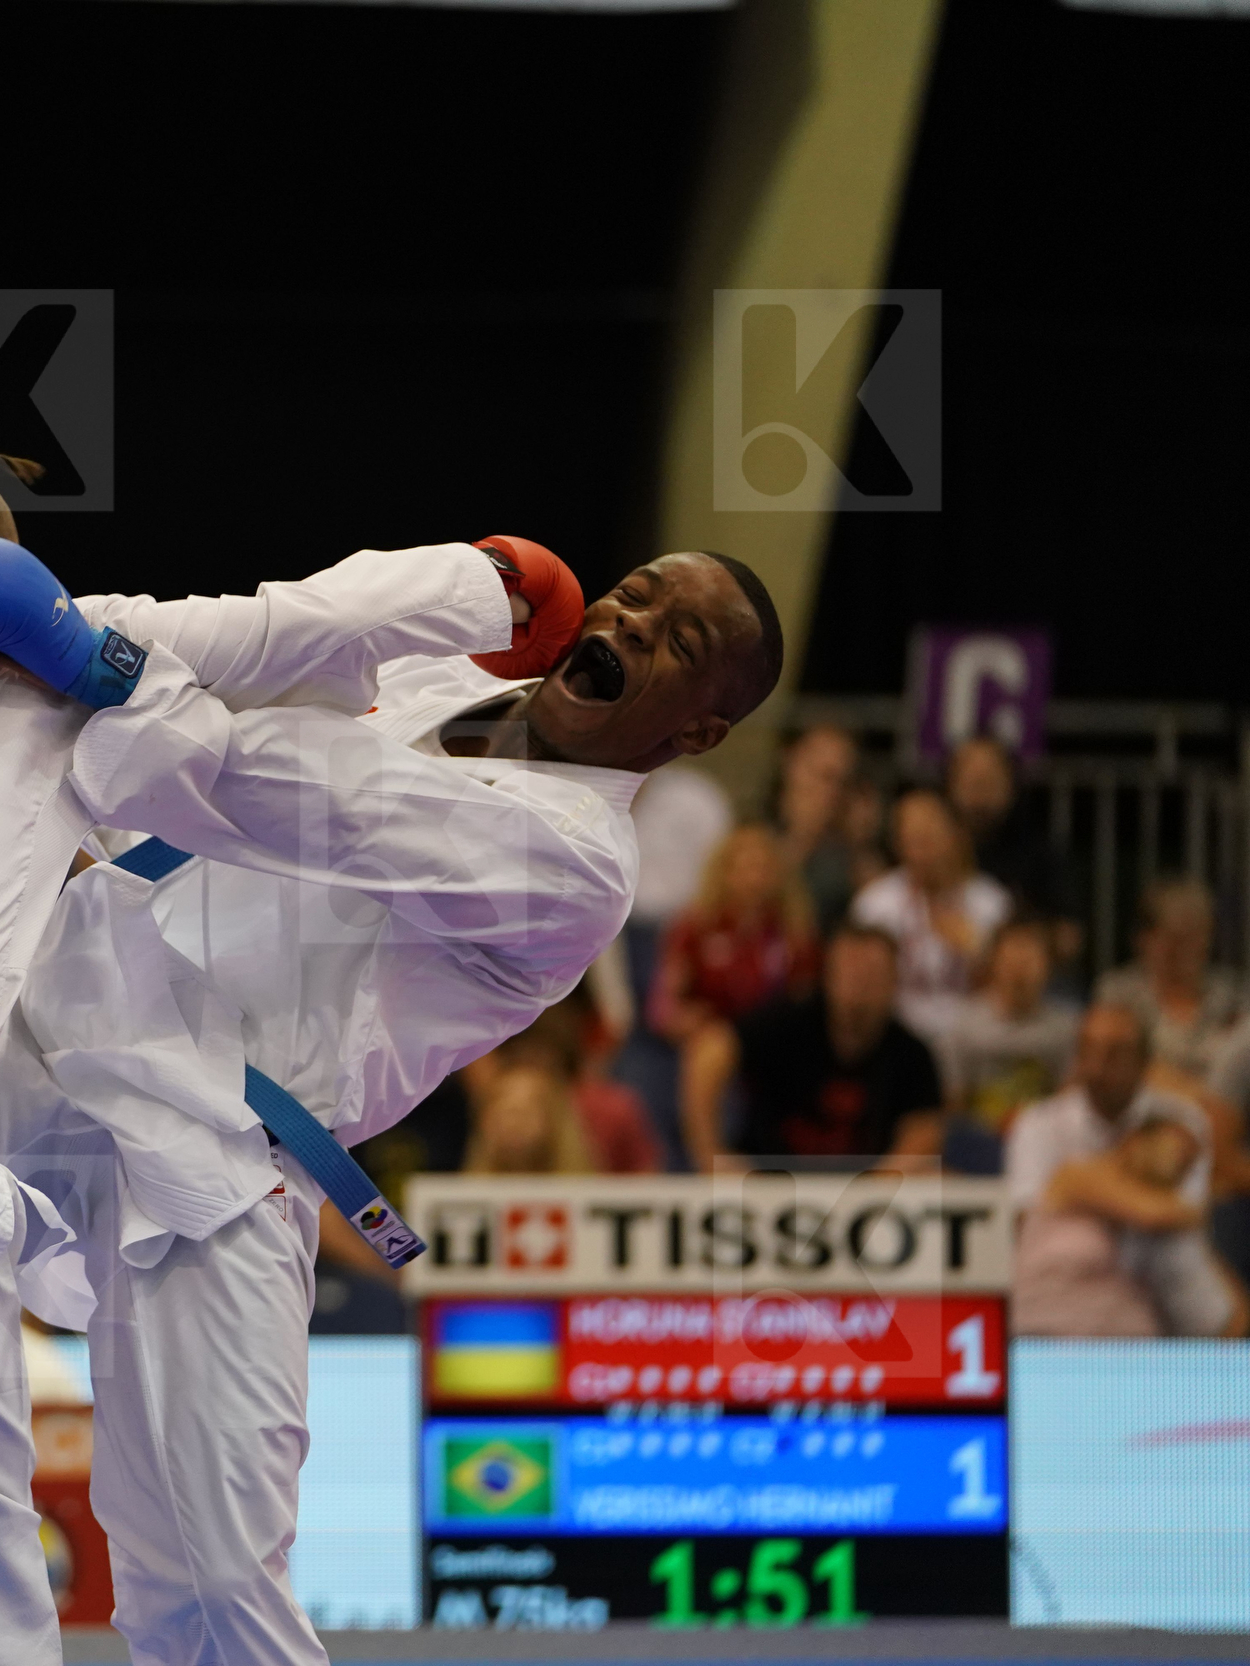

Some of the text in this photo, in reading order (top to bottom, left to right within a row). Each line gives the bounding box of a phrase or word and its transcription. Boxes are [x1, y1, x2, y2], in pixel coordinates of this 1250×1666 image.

[588, 1206, 990, 1271] TISSOT
[946, 1314, 1001, 1397] 1
[947, 1438, 1001, 1517] 1
[651, 1539, 871, 1630] 1:51
